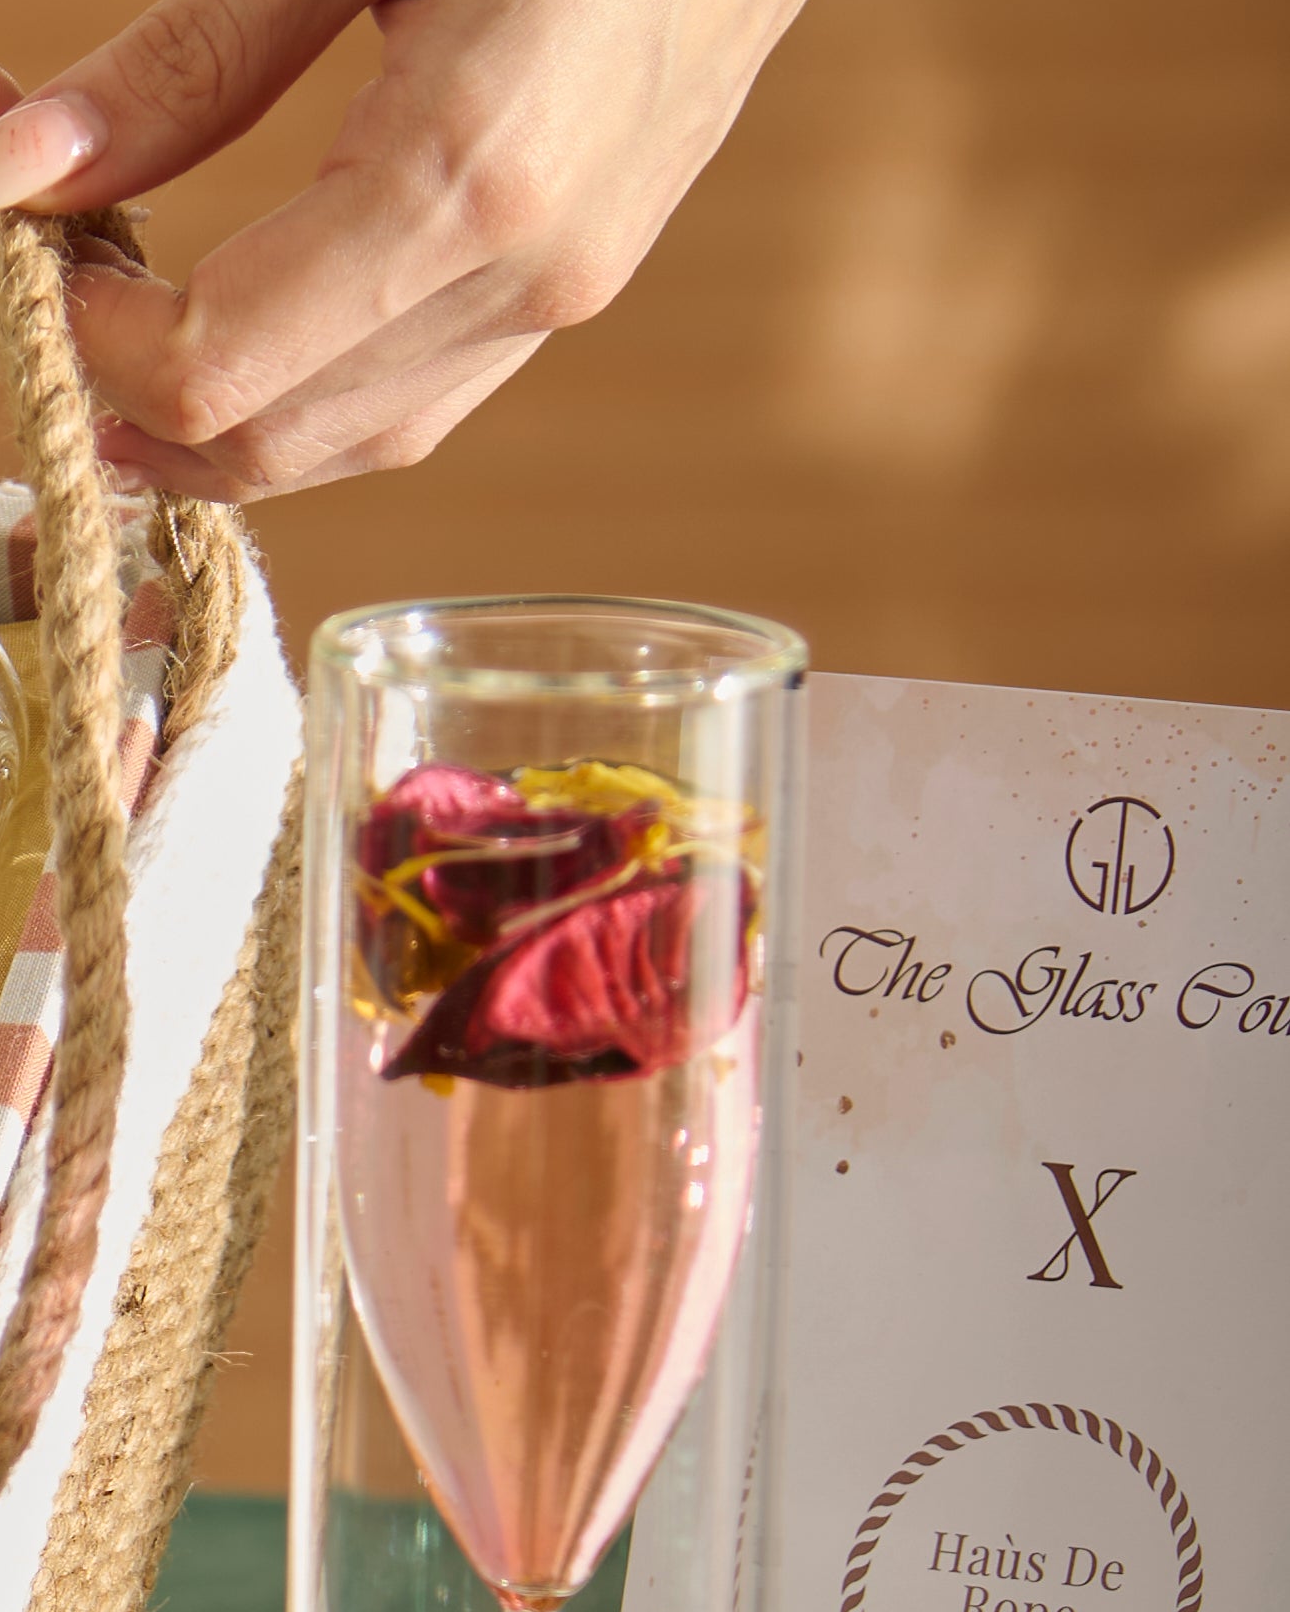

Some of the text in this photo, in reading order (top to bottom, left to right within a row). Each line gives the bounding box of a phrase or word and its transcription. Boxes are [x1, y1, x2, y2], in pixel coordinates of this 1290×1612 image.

[819, 925, 952, 1003] The
[966, 944, 1158, 1036] Glass
[1026, 1161, 1138, 1290] X
[927, 1531, 1125, 1592] Haùs De
